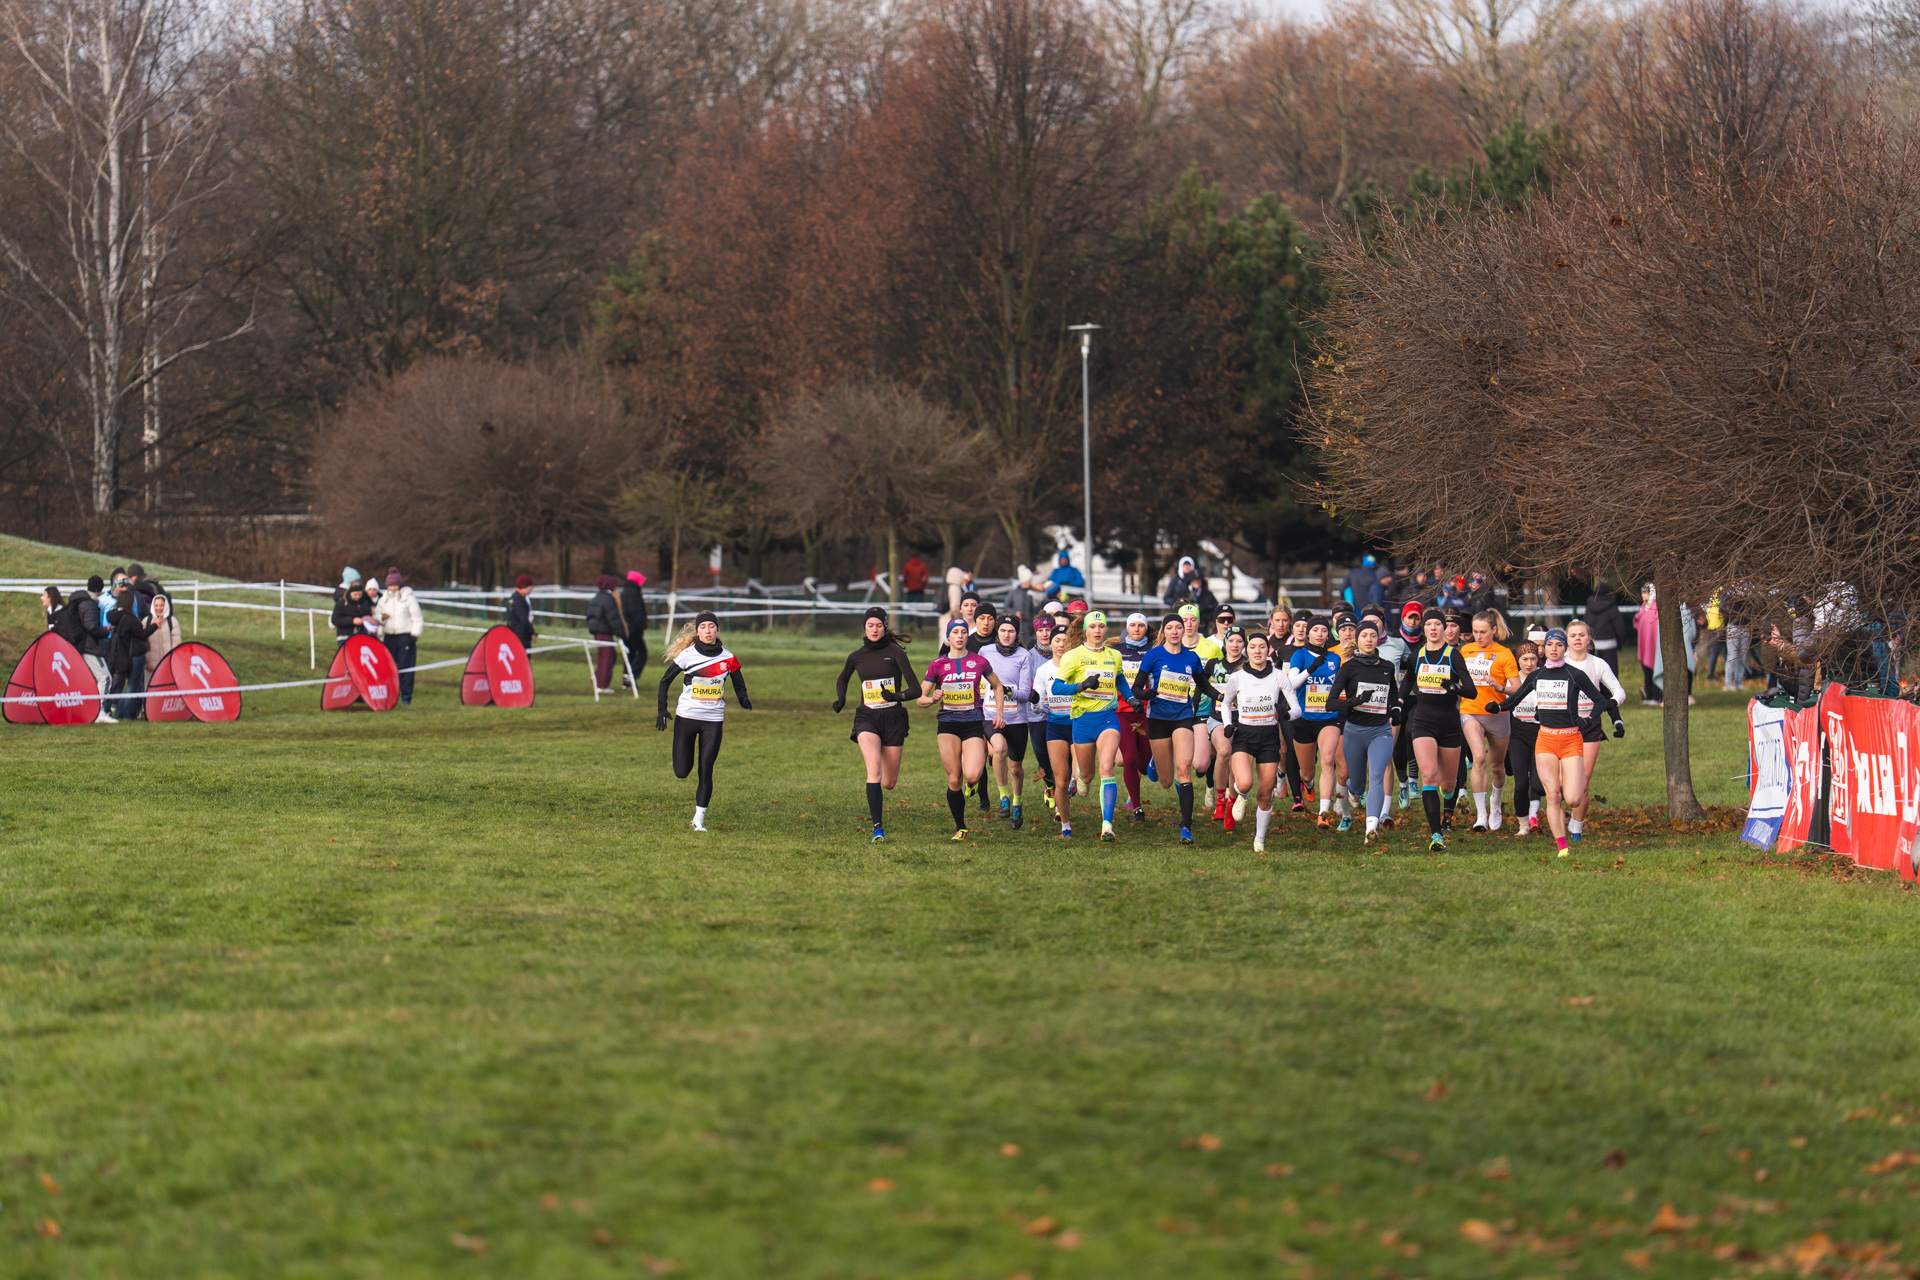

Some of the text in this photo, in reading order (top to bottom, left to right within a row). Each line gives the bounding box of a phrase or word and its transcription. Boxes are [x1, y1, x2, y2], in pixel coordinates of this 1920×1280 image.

[943, 672, 977, 681] AMS
[1307, 676, 1325, 684] SLV
[692, 687, 722, 695] CHMURA
[198, 696, 224, 711] ORLEN
[1370, 696, 1386, 704] LARZ
[1242, 703, 1273, 713] SZYMAŃSKA
[1541, 727, 1558, 735] NIKE
